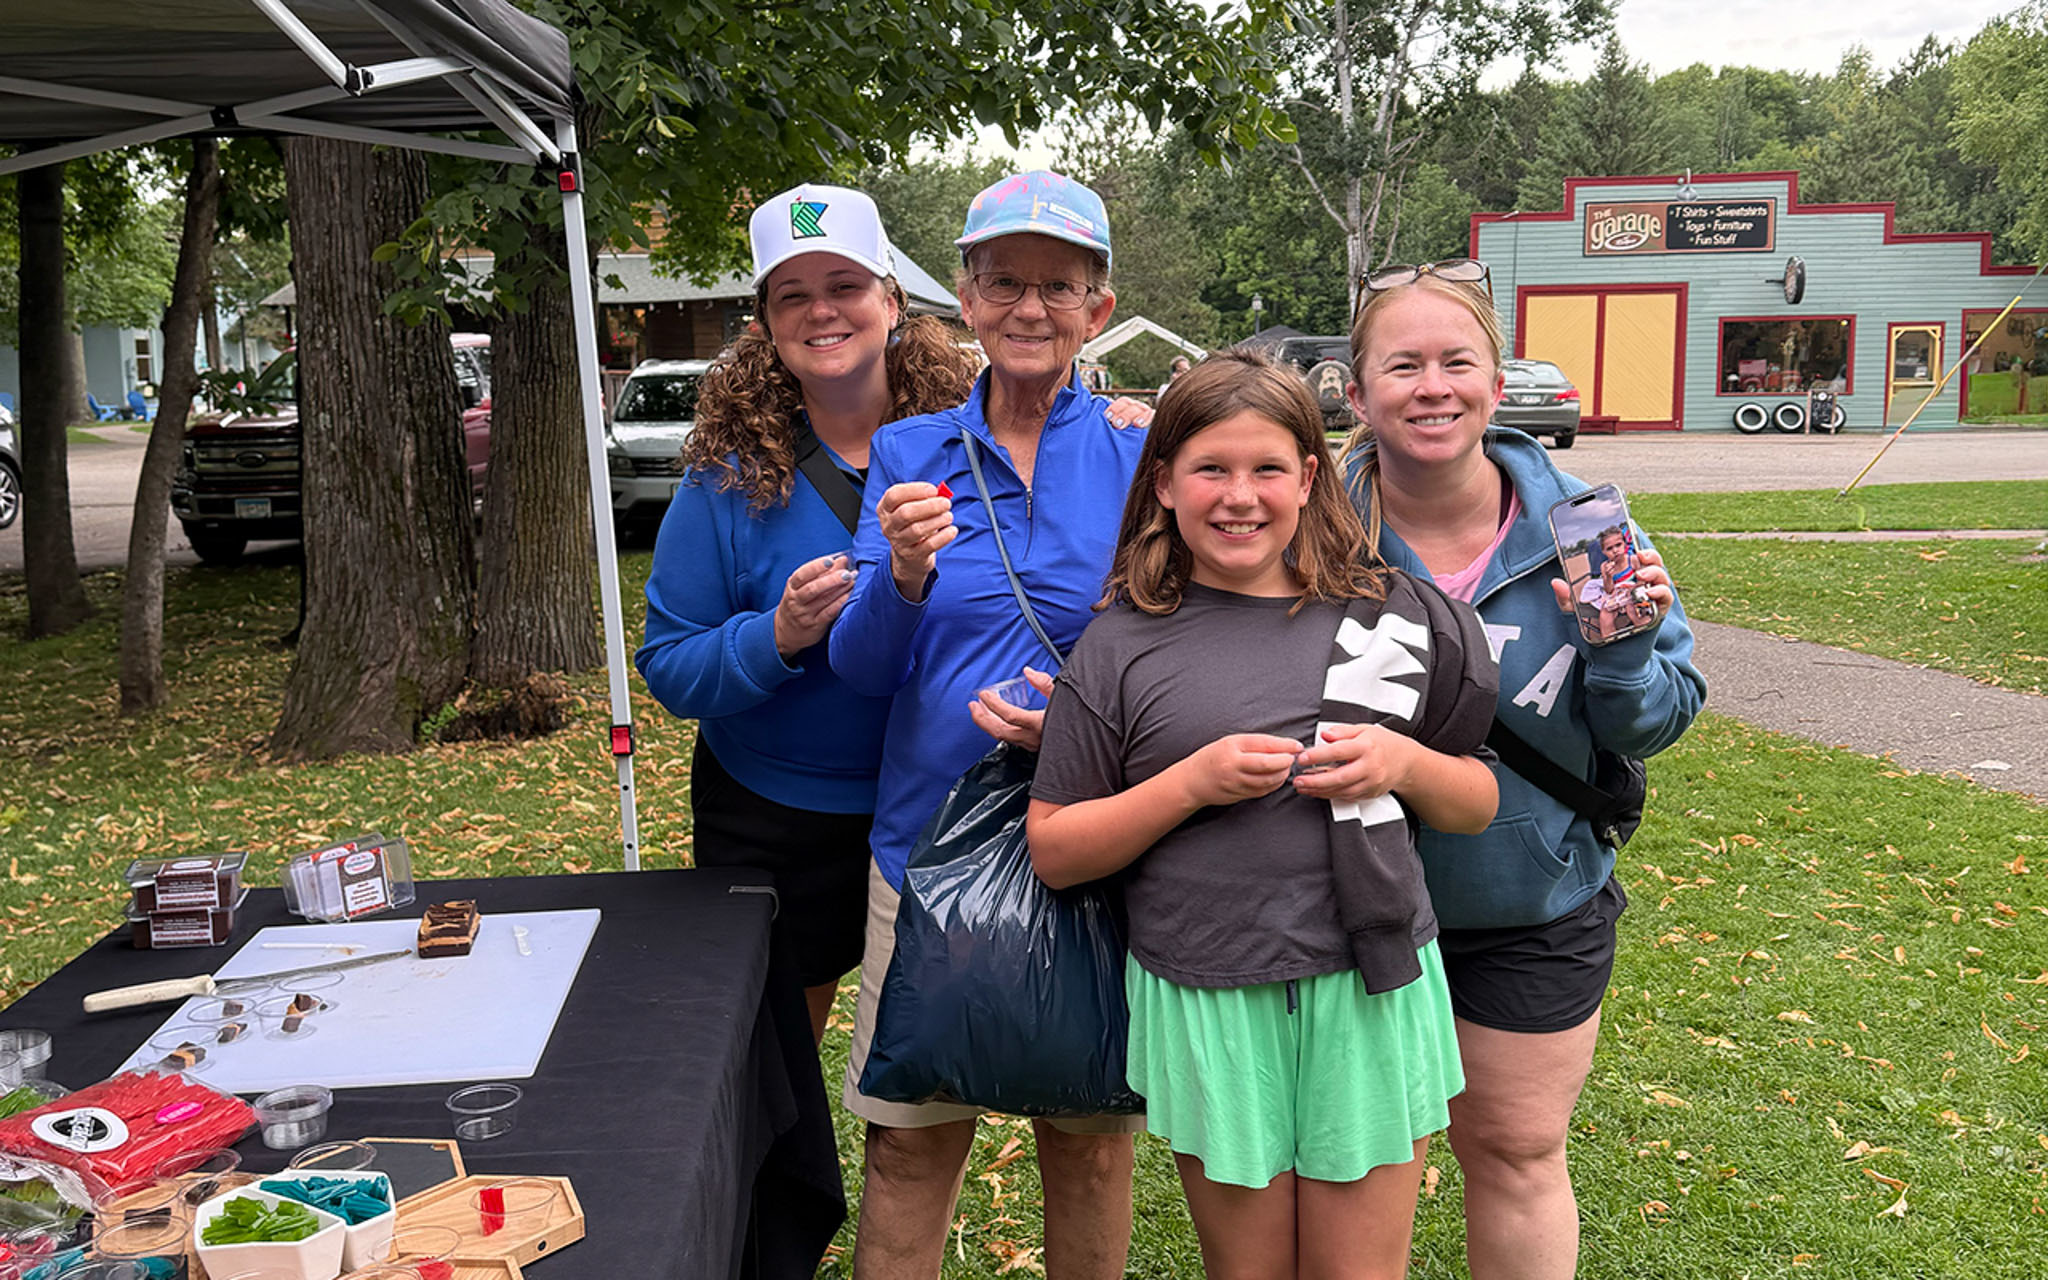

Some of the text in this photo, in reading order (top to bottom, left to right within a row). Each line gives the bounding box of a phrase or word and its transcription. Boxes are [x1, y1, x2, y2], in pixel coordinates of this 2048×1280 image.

[1682, 206, 1708, 218] Shirts
[1715, 205, 1768, 217] Sweatshirts
[1590, 212, 1662, 250] garage
[1685, 218, 1754, 233] Toys Furniture
[1694, 232, 1738, 245] Fun Stuff
